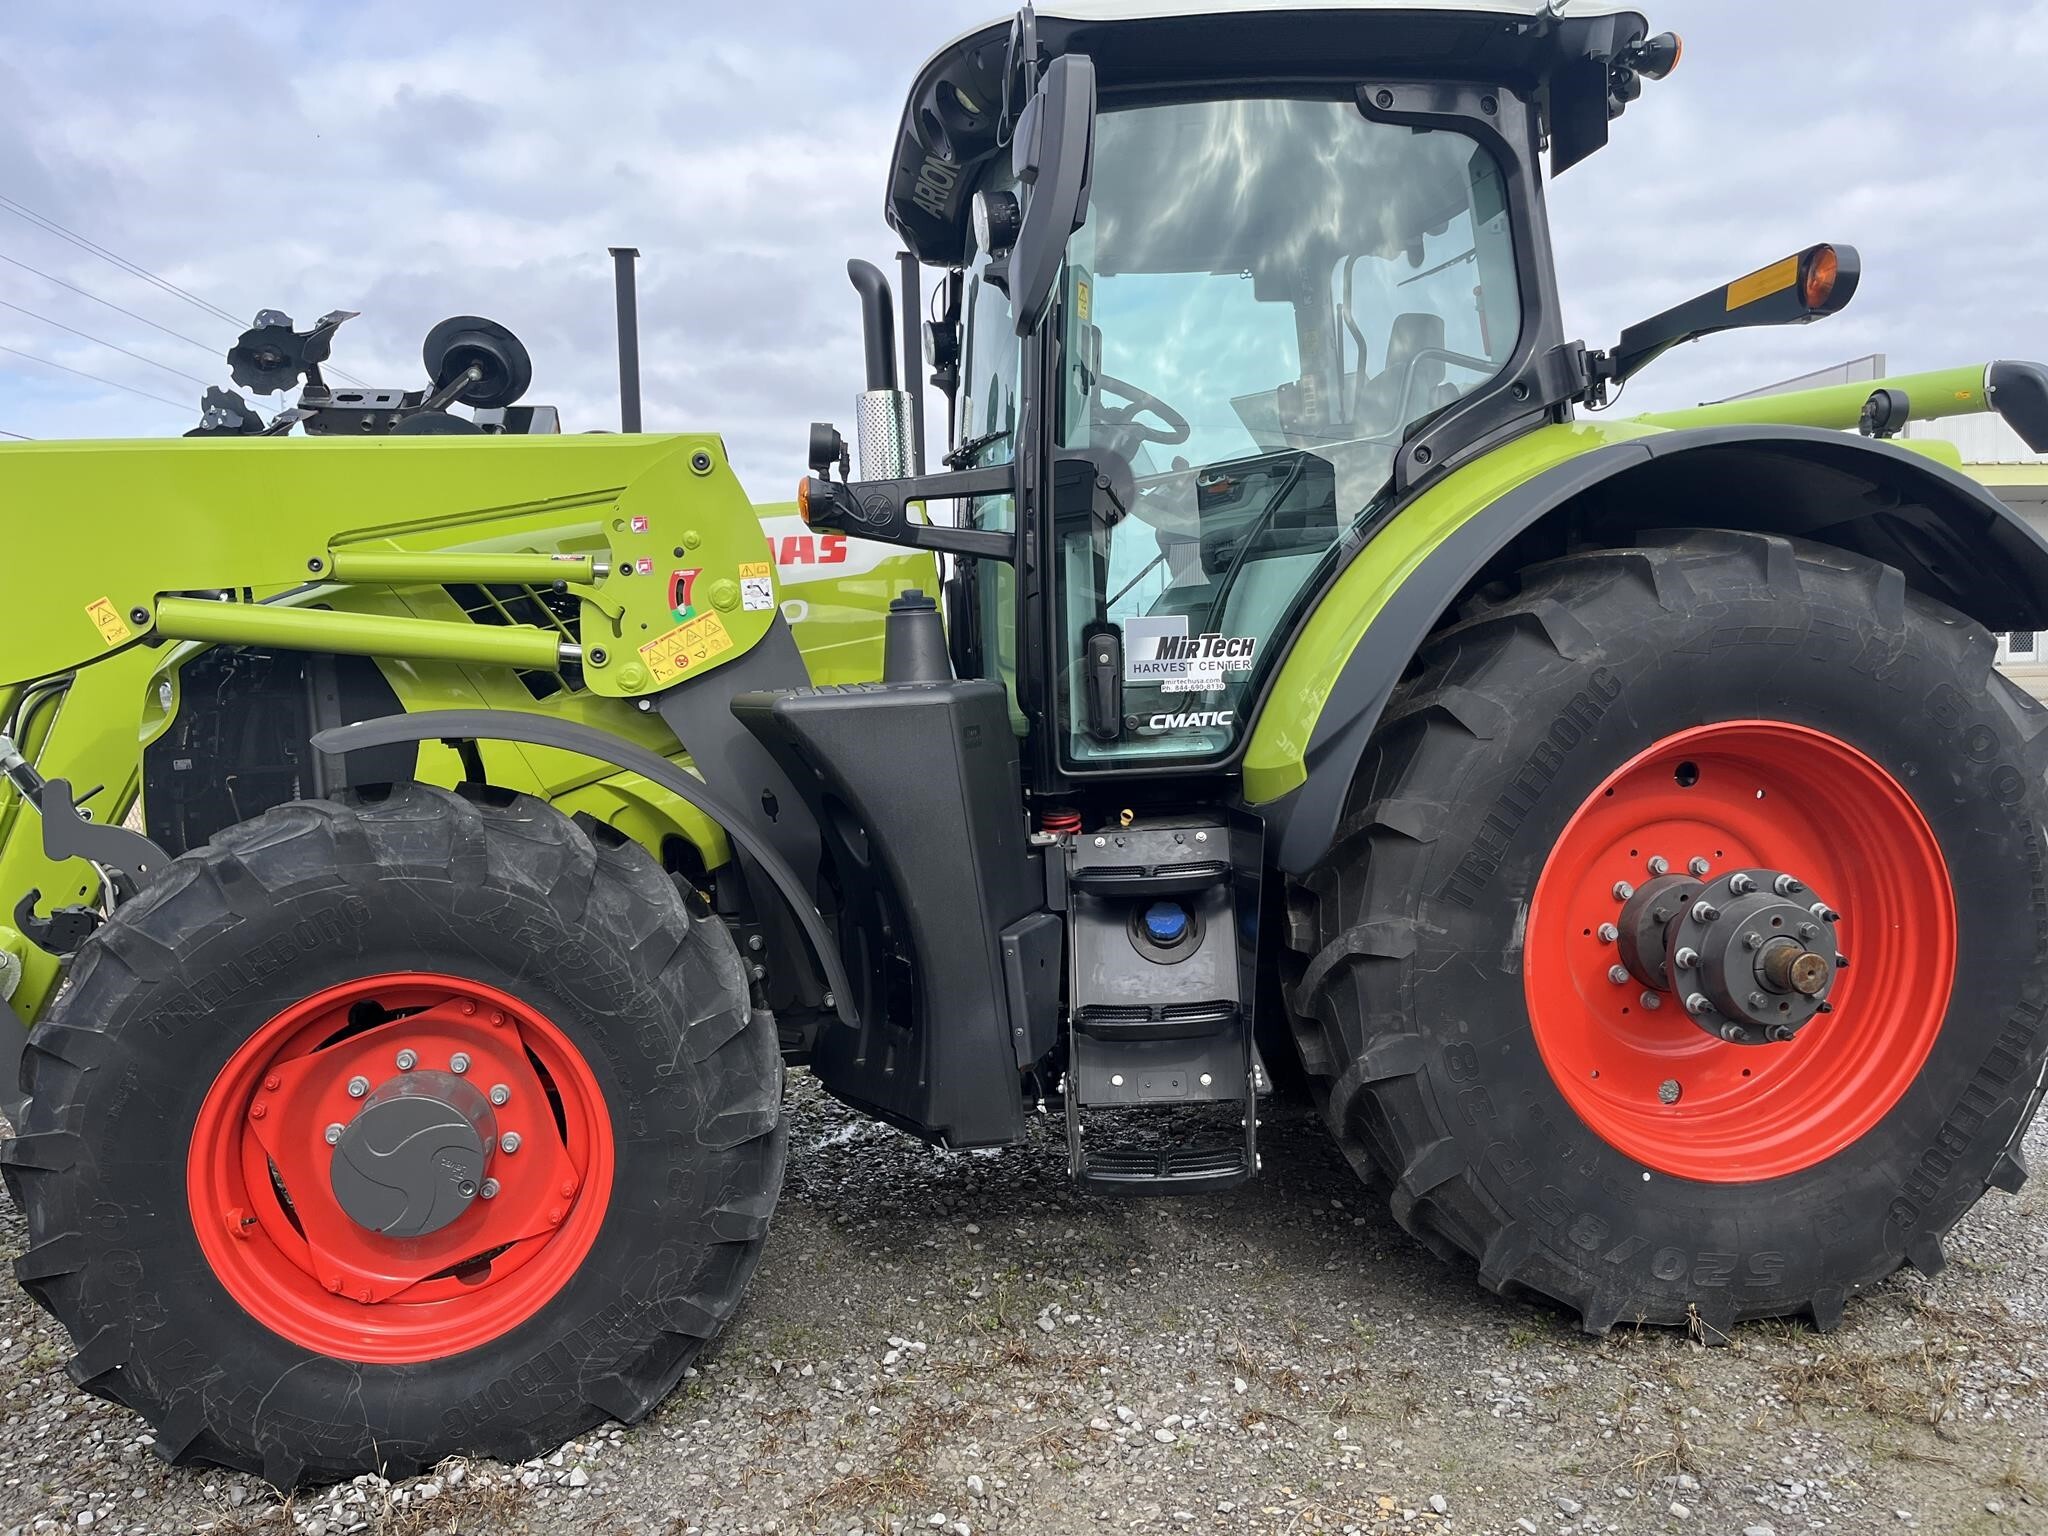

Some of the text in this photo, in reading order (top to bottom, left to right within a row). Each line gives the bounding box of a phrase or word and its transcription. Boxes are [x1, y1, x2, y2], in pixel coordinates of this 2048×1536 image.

[913, 155, 961, 220] ARION
[1133, 659, 1251, 674] HARVEST CENTER
[1149, 710, 1234, 730] CMATIC
[1433, 665, 1623, 912] TRELLEBORG
[138, 894, 373, 1040] TRELLEBORG
[1886, 999, 2048, 1232] TRELLEBORG
[438, 1289, 651, 1441] TRELLEBORG
